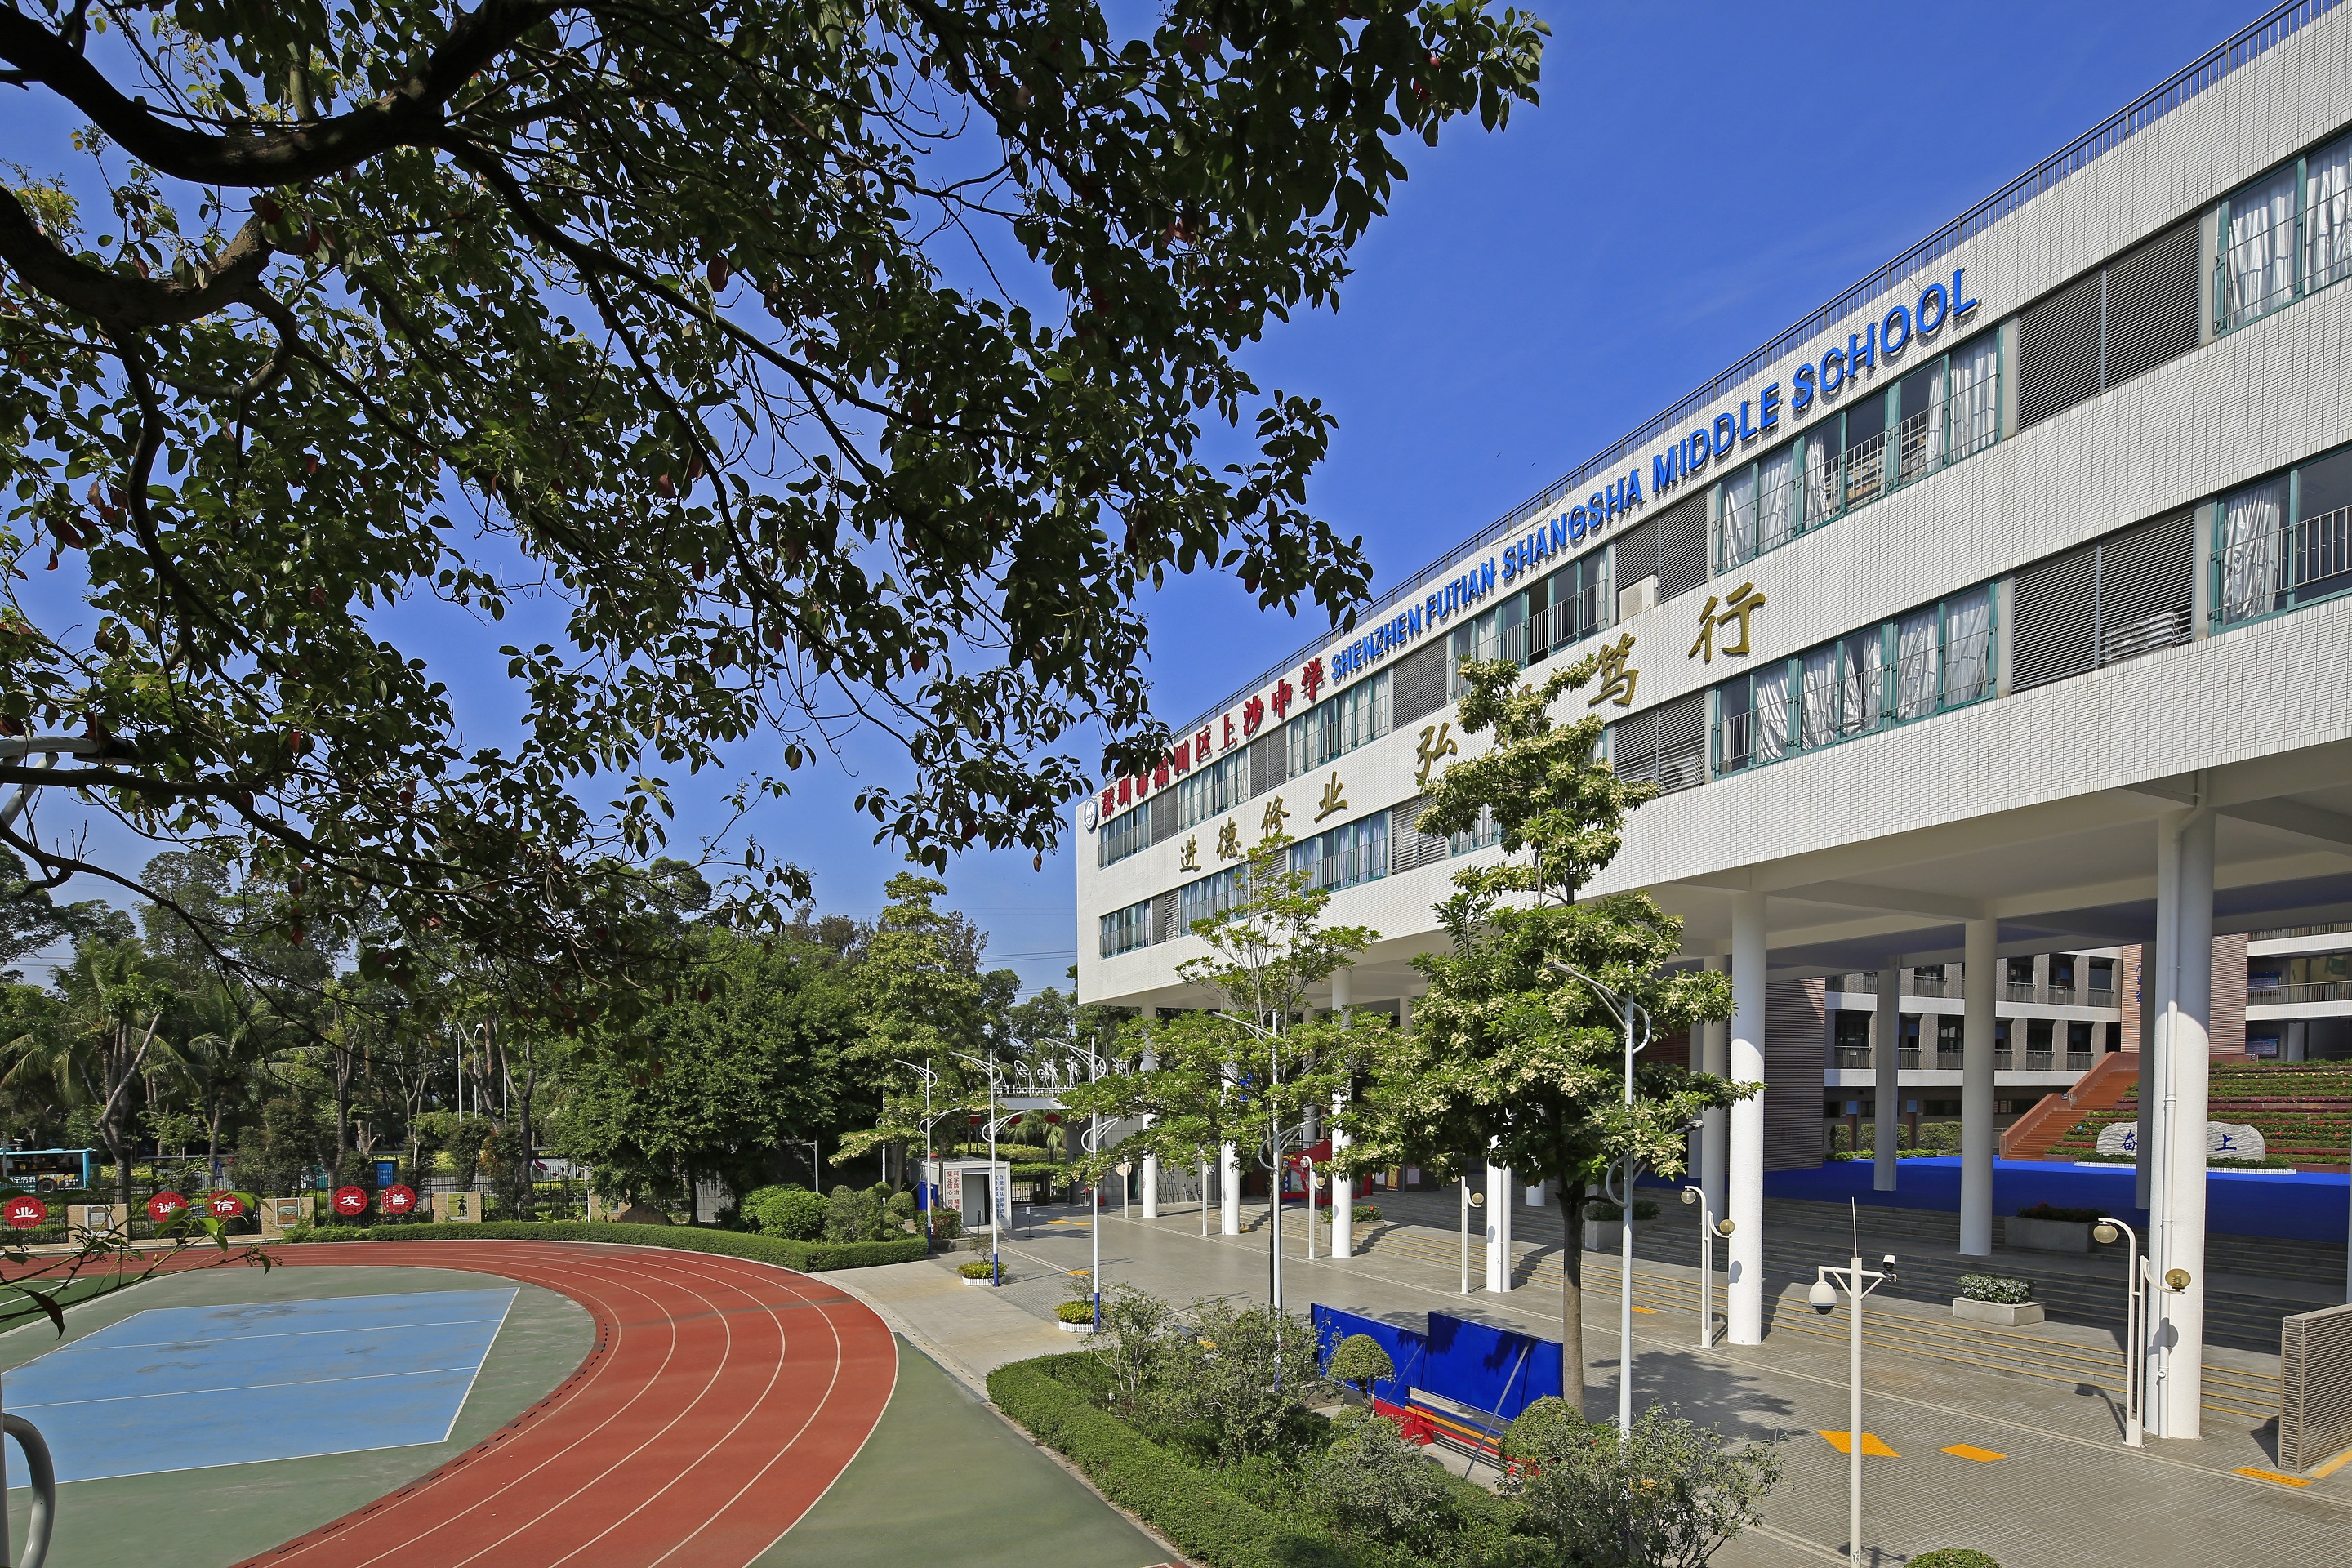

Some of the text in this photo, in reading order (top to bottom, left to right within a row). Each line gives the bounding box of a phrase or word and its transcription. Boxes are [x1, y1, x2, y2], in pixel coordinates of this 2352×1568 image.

[1330, 269, 1977, 682] SHENZHEN FUTIAN SHANGSHA MIDDLE SCHOOL
[13, 1206, 38, 1219] 业
